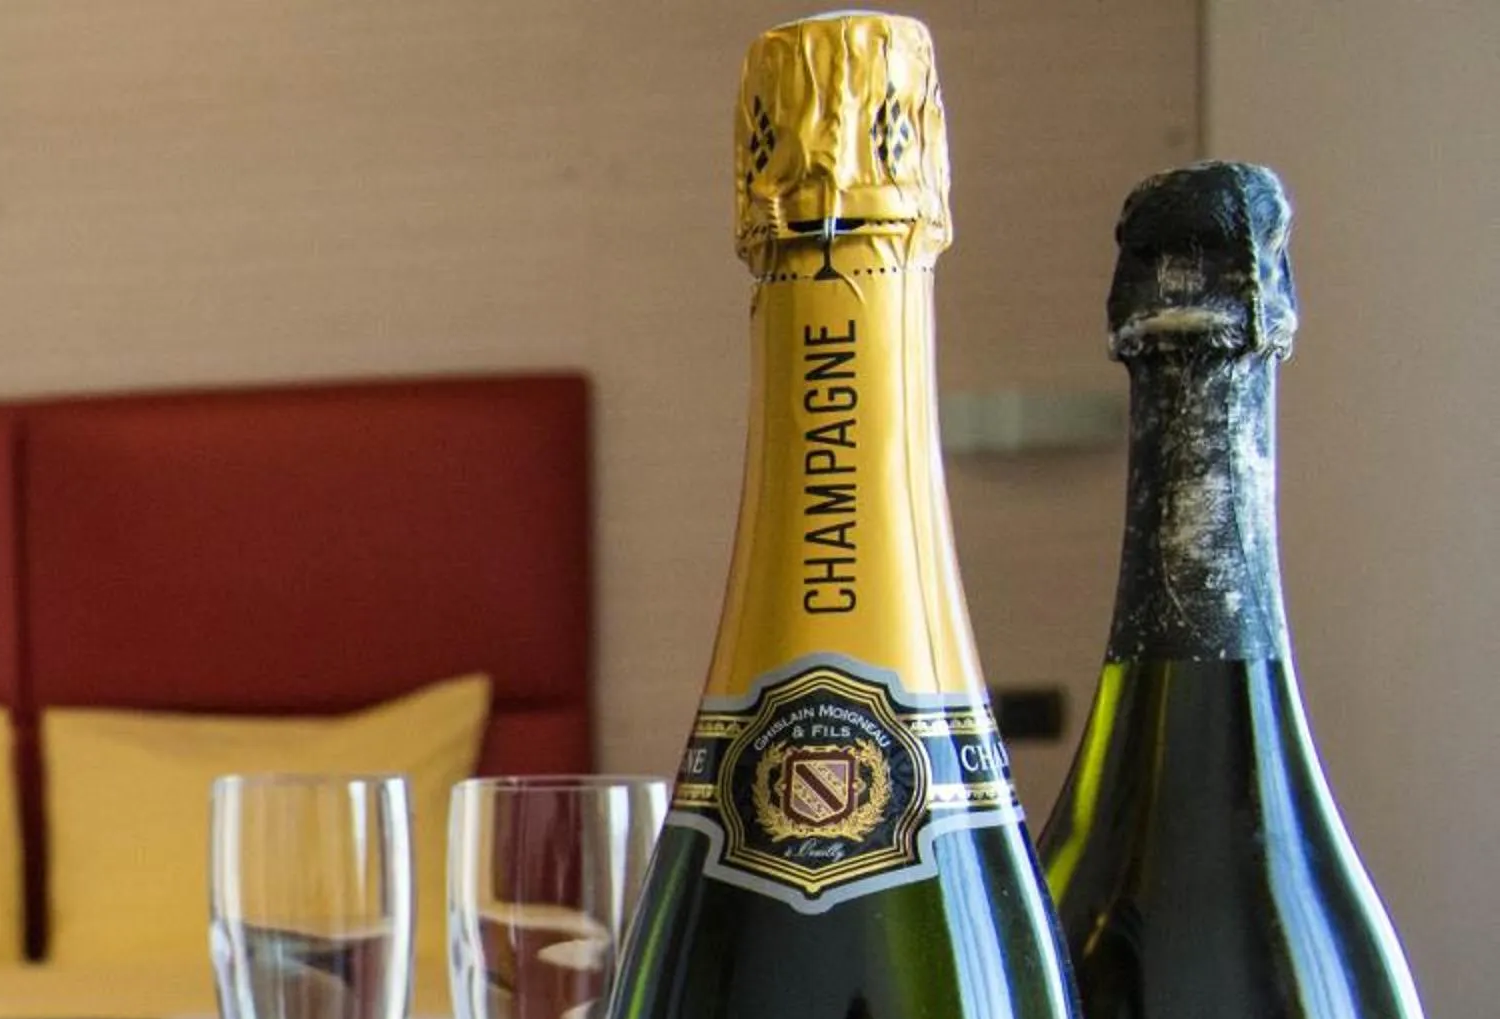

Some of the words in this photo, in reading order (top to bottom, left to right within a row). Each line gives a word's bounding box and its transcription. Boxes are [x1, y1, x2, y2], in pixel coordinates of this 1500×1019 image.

[803, 319, 857, 614] CHAMPAGNE
[754, 705, 816, 751] GHISLAIN
[818, 704, 891, 747] MOIGNEAU
[811, 724, 851, 738] FILS
